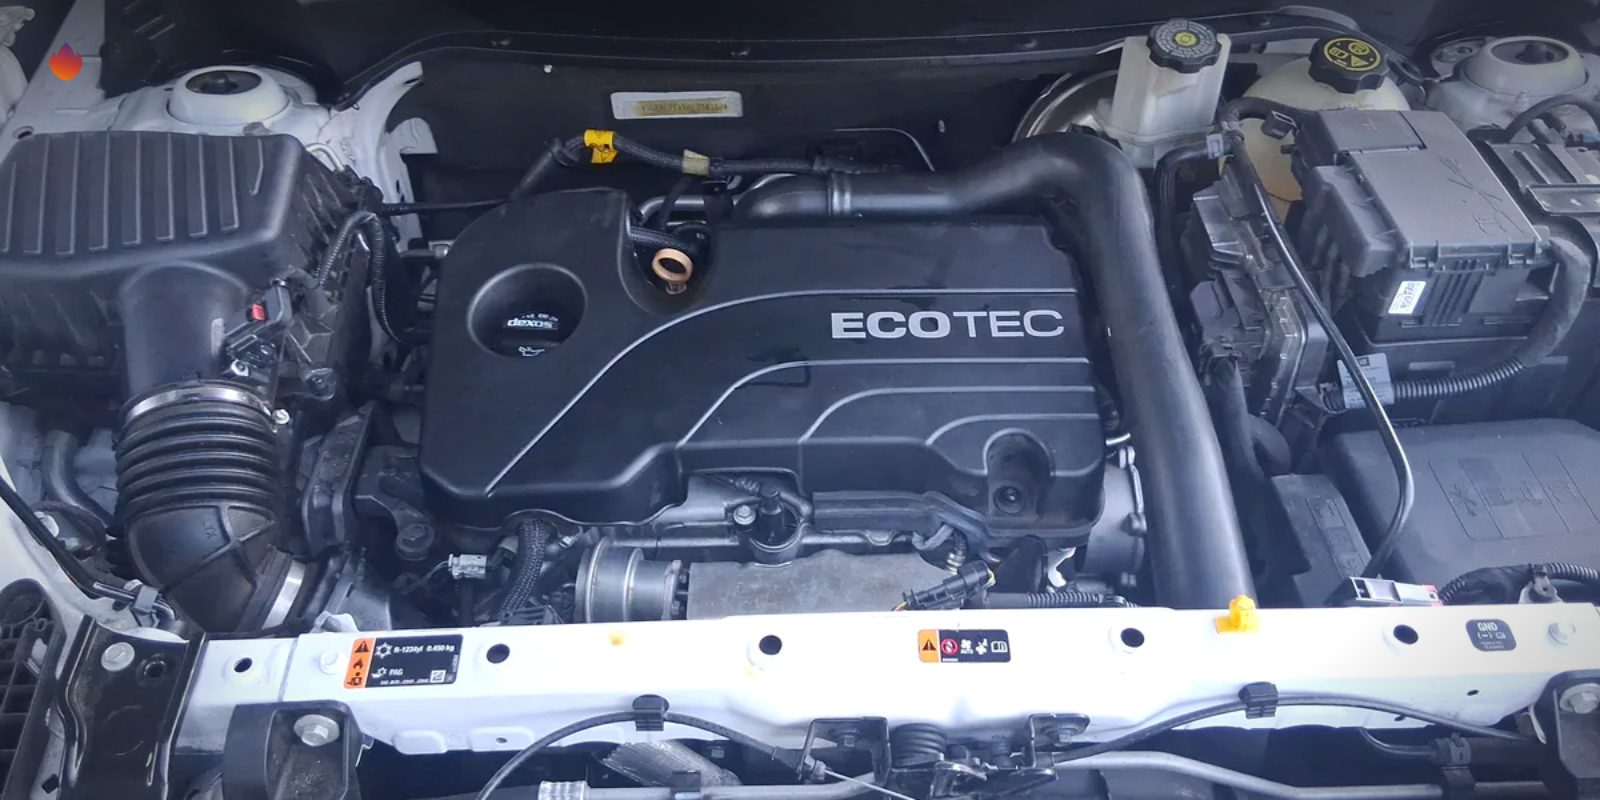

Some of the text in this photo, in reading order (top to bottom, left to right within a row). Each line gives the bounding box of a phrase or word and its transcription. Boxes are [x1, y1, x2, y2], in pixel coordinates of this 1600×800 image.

[507, 318, 553, 329] dexos
[831, 310, 1065, 339] ECOTEC
[1477, 622, 1498, 631] GND
[446, 644, 455, 652] kg
[388, 668, 403, 676] PAG
